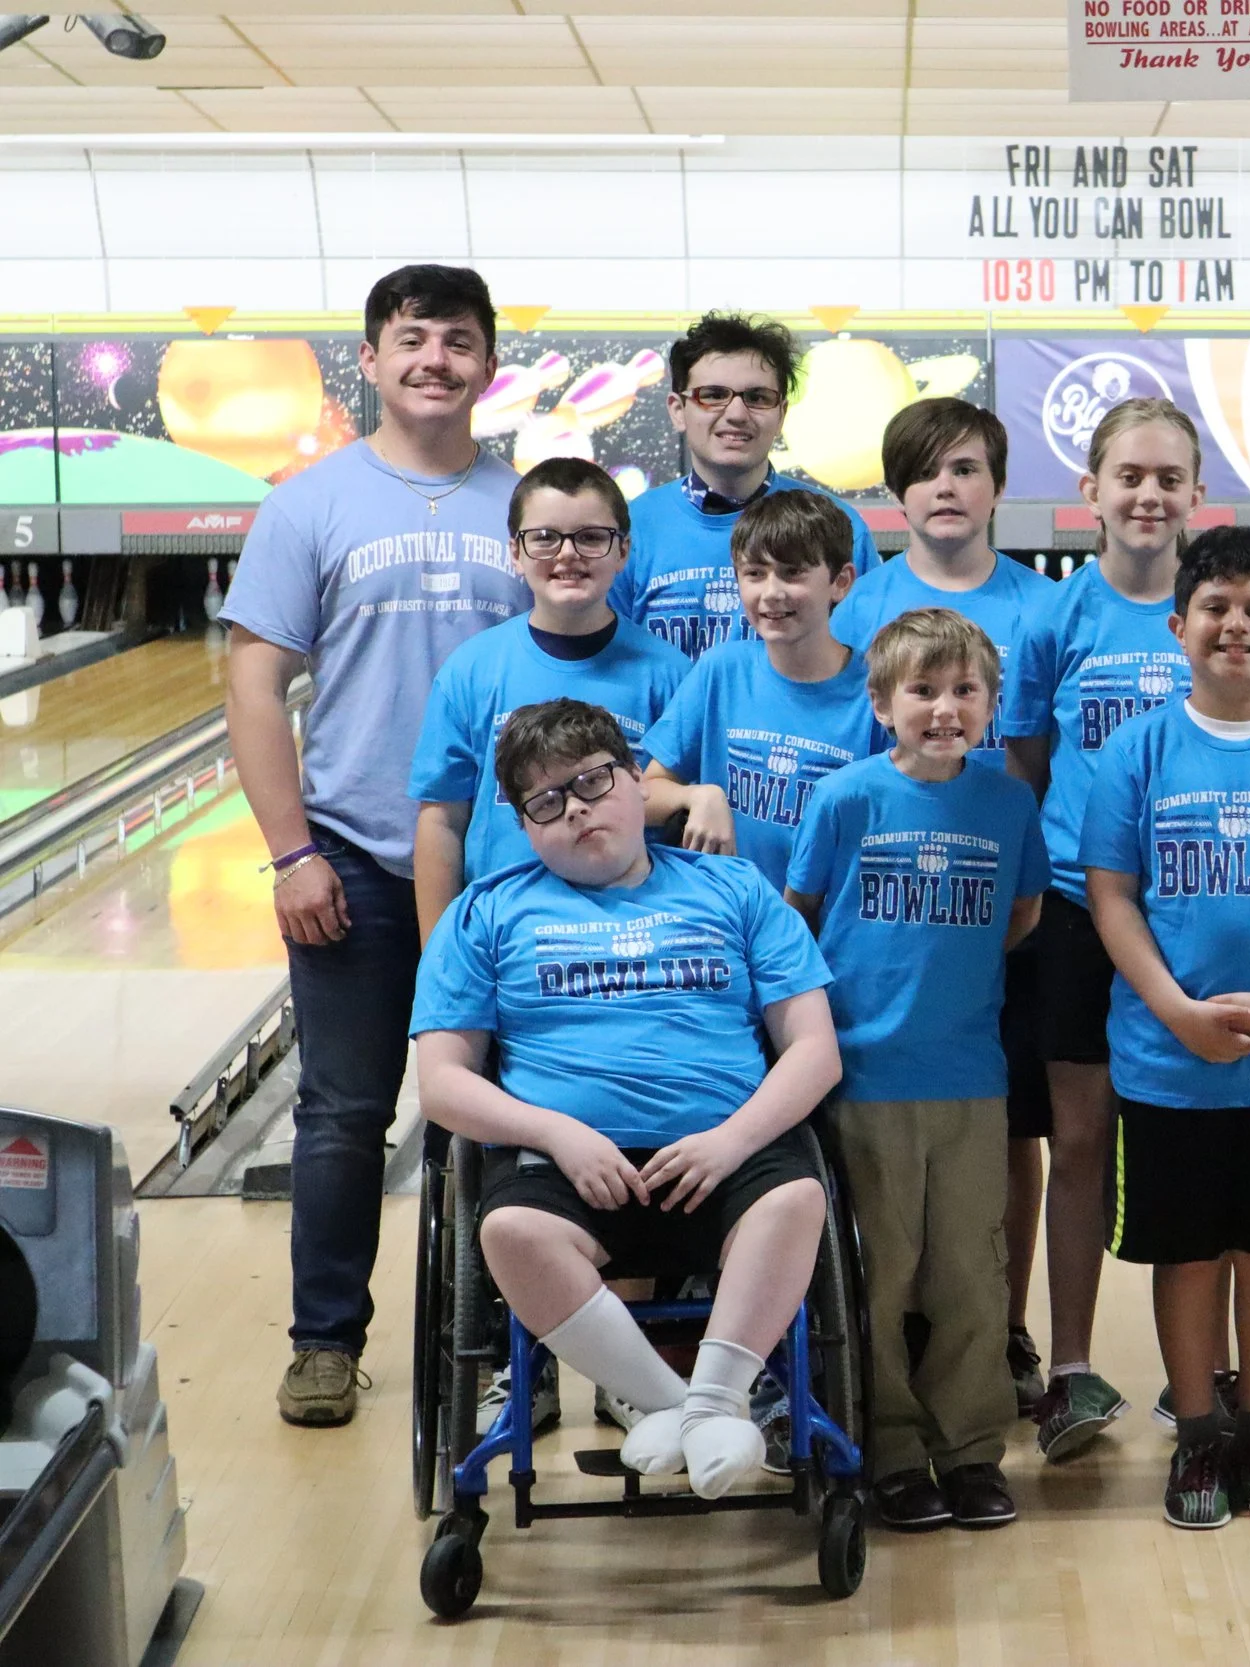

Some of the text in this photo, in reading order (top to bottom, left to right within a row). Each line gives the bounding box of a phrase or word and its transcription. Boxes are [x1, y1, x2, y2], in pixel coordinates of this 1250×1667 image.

[1084, 0, 1110, 17] NO
[1122, 0, 1171, 17] FOOD
[1183, 0, 1208, 16] OR
[1085, 21, 1150, 38] BOWLING
[1119, 48, 1200, 69] Thank
[1006, 144, 1198, 188] FRI AND SAT
[968, 195, 1232, 239] ALL YOU CAN BOWL
[982, 258, 1055, 302] 1030
[1073, 259, 1110, 301] PM
[1130, 260, 1163, 302] TO
[14, 515, 34, 548] 5
[186, 514, 243, 529] AMF
[461, 533, 517, 579] THERA
[377, 600, 426, 615] UNIVERSITY
[435, 599, 473, 612] CENTRAL
[474, 600, 510, 617] RKANSA
[784, 734, 854, 763] CONNECTIONS
[726, 762, 816, 828] BOWLI
[1155, 791, 1228, 812] COMMUNITY
[861, 831, 1000, 854] COMMUNITY CONNECTIONS
[859, 871, 996, 928] BOWLING
[535, 911, 682, 936] COMMUNITY CONNEC
